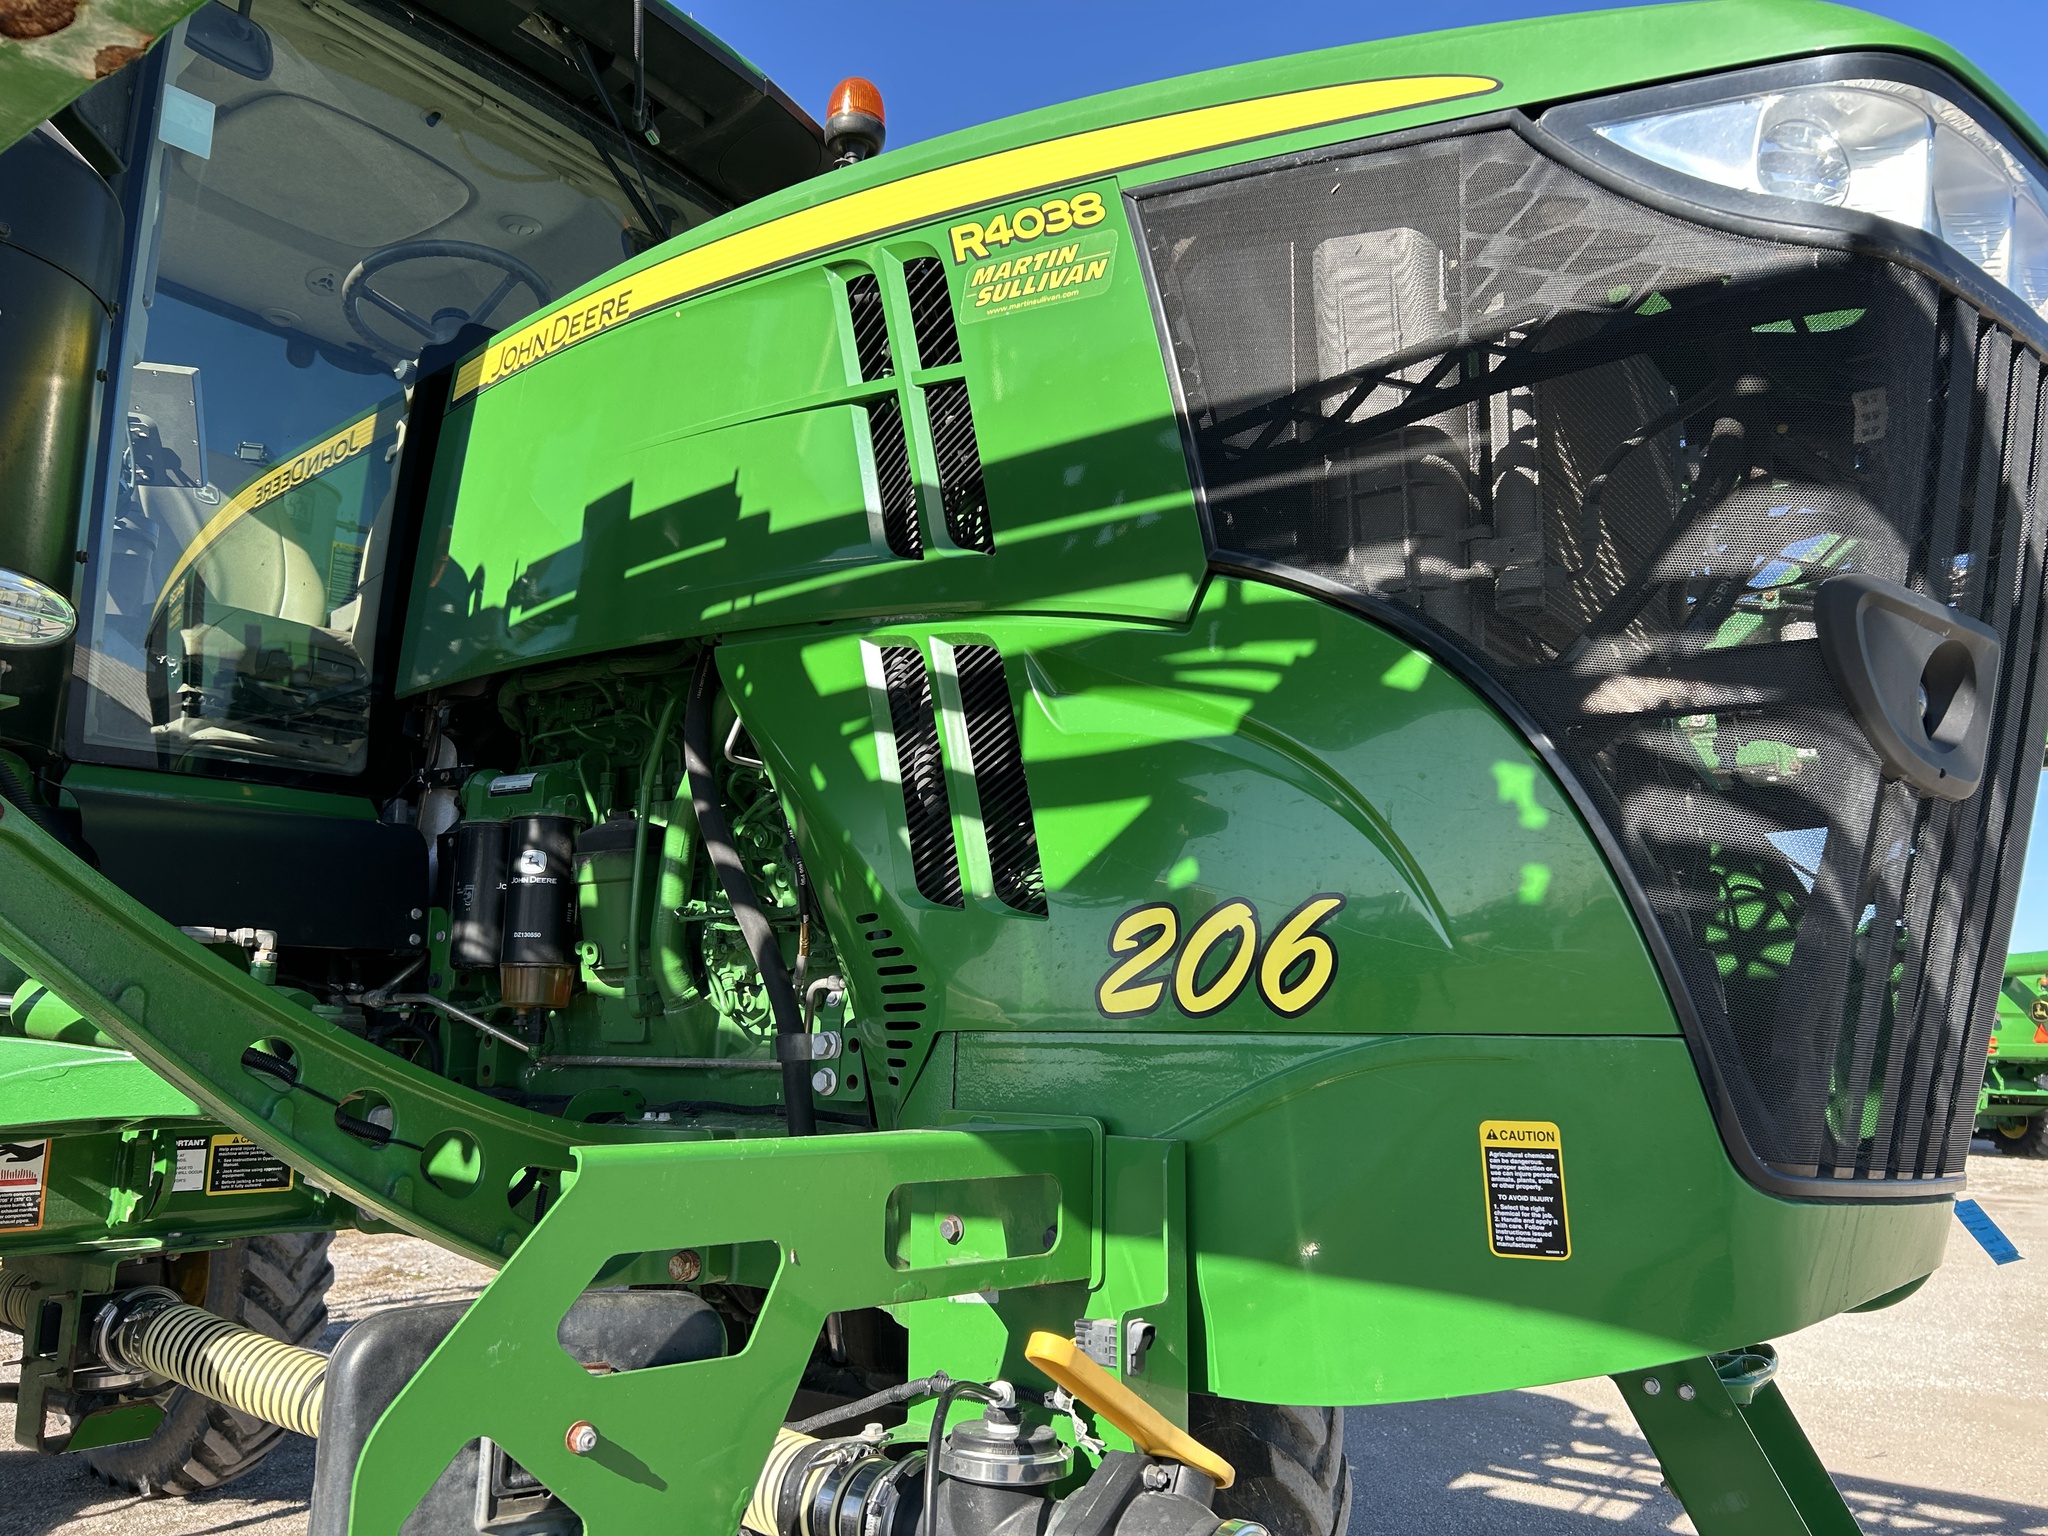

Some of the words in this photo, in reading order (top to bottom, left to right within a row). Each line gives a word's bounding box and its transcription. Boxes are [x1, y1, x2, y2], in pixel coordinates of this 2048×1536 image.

[948, 192, 1106, 265] R4038
[970, 244, 1080, 288] MARTIN
[975, 258, 1109, 308] SULLIVAN
[987, 289, 1079, 315] www.martinsullivan.com
[491, 328, 548, 378] JOHN
[551, 290, 632, 347] DEERE
[530, 876, 557, 884] DEERE
[1095, 893, 1347, 1019] 206
[1500, 1130, 1554, 1142] CAUTION
